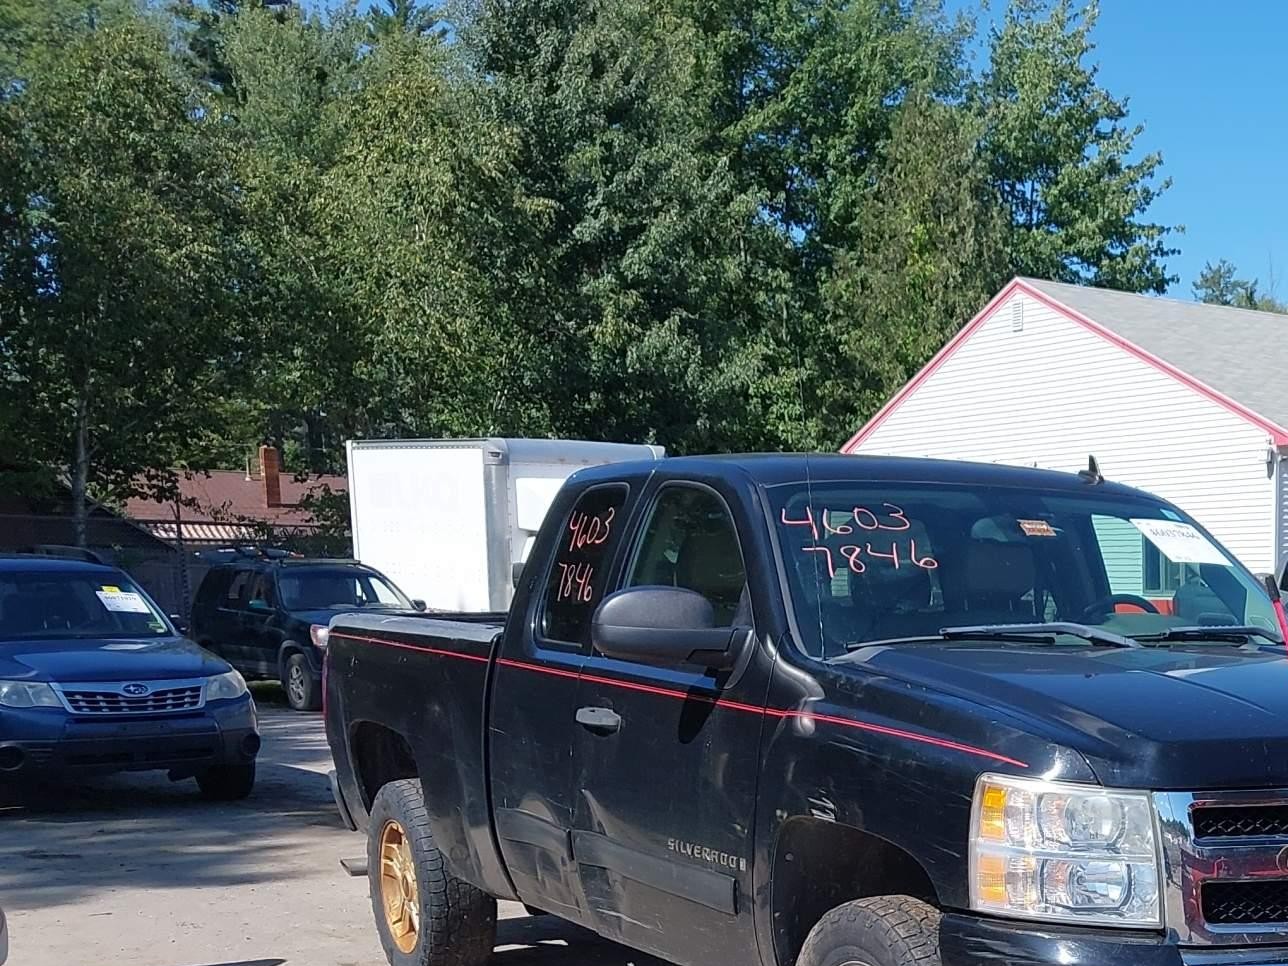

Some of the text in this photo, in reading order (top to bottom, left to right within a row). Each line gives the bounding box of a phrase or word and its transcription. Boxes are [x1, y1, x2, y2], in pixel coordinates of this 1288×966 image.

[569, 507, 615, 552] 4603
[781, 503, 911, 541] 4603
[801, 539, 938, 578] 7846
[558, 562, 594, 602] 7846
[667, 837, 738, 868] SILVERADO
